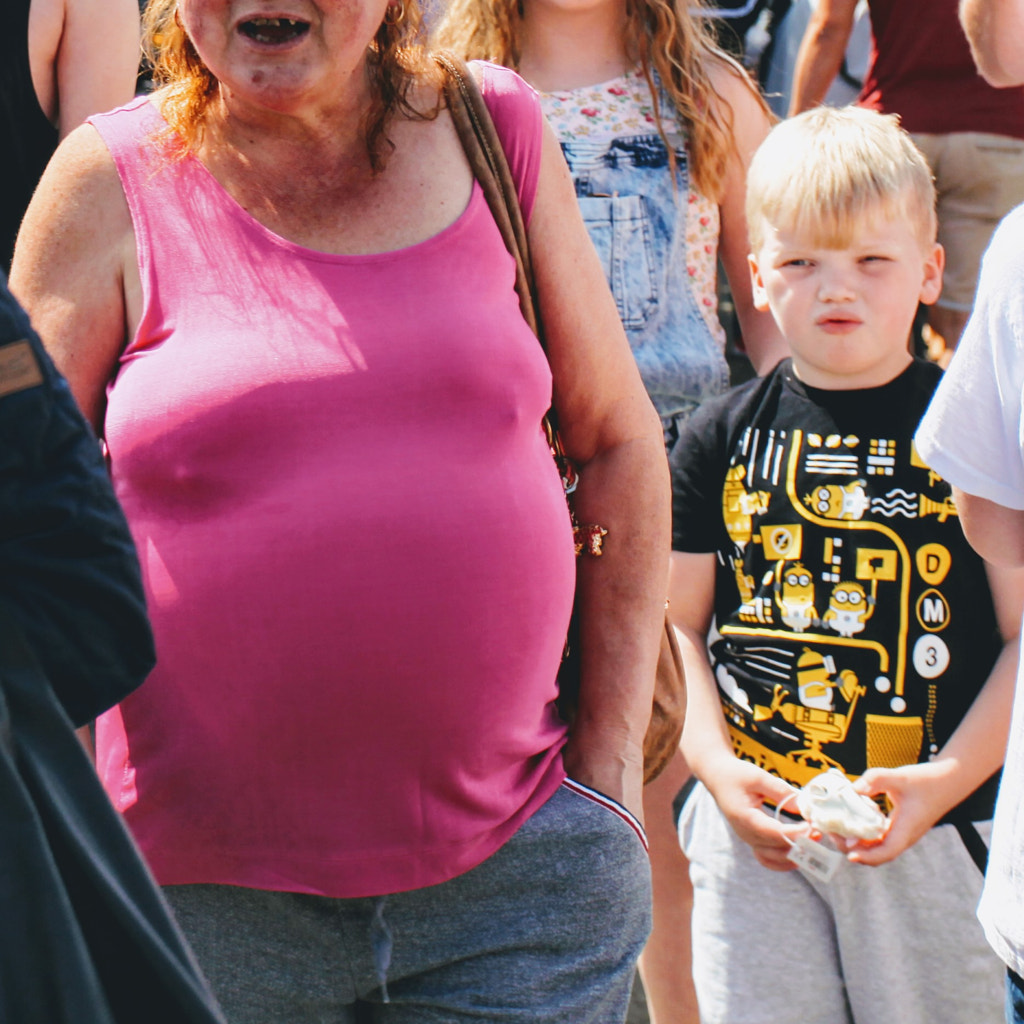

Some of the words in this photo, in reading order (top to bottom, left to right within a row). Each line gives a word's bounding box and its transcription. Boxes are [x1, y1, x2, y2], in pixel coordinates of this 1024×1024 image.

[927, 554, 941, 573] D
[923, 598, 944, 623] M
[925, 646, 938, 667] 3
